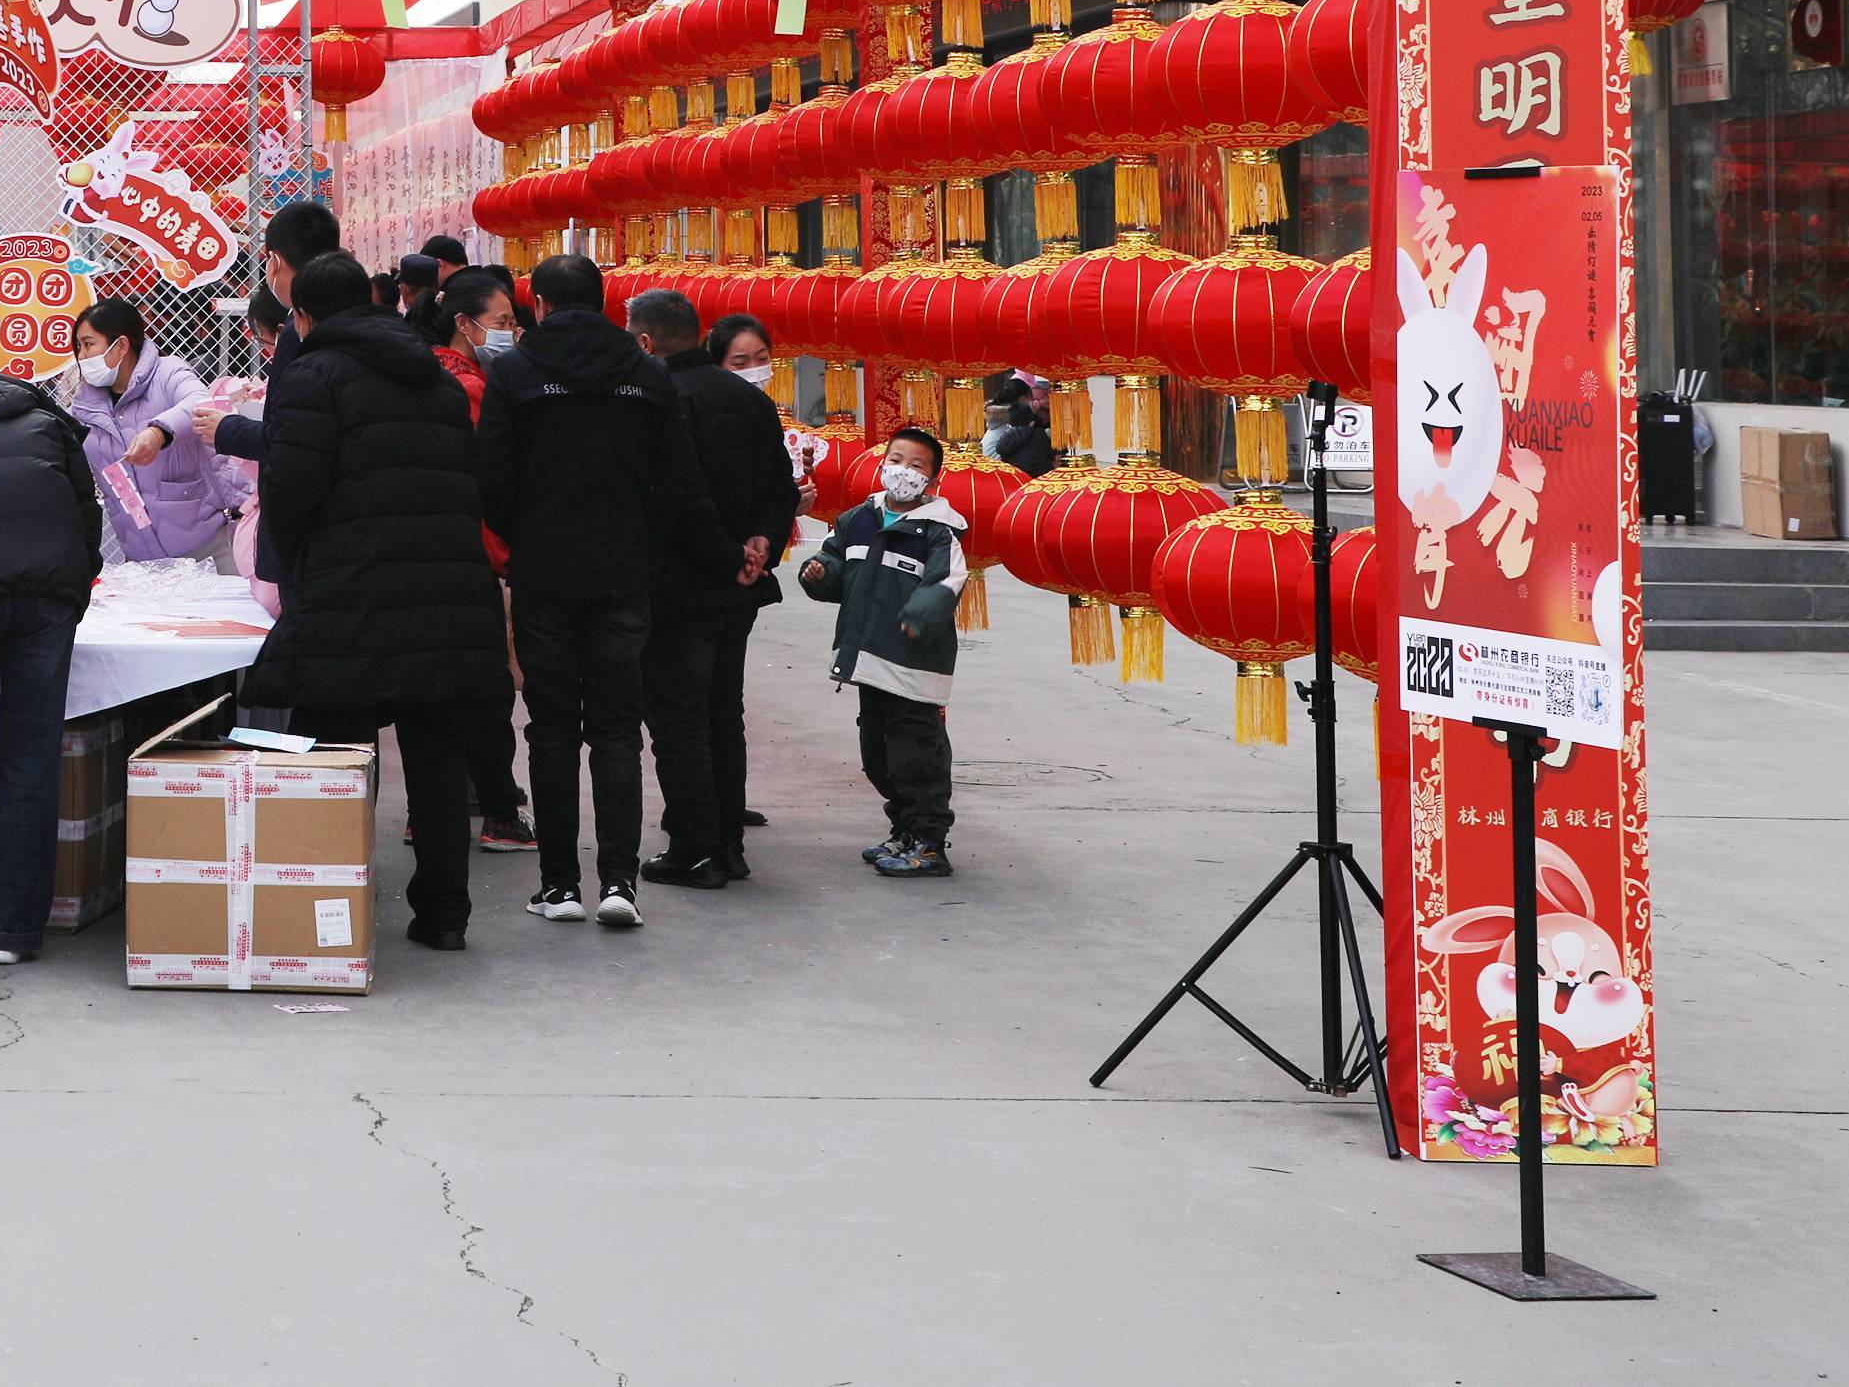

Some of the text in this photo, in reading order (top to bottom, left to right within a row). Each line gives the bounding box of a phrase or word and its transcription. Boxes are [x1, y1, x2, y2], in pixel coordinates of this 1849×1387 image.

[0, 51, 36, 97] 2023
[1581, 185, 1603, 196] 2023
[121, 185, 221, 261] 心中的麦田
[1581, 212, 1603, 222] 02.05
[0, 239, 54, 258] 2023
[1505, 398, 1594, 427] YUANXIAO
[1505, 425, 1564, 452] KUAILE
[1458, 806, 1613, 828] 林州商银行
